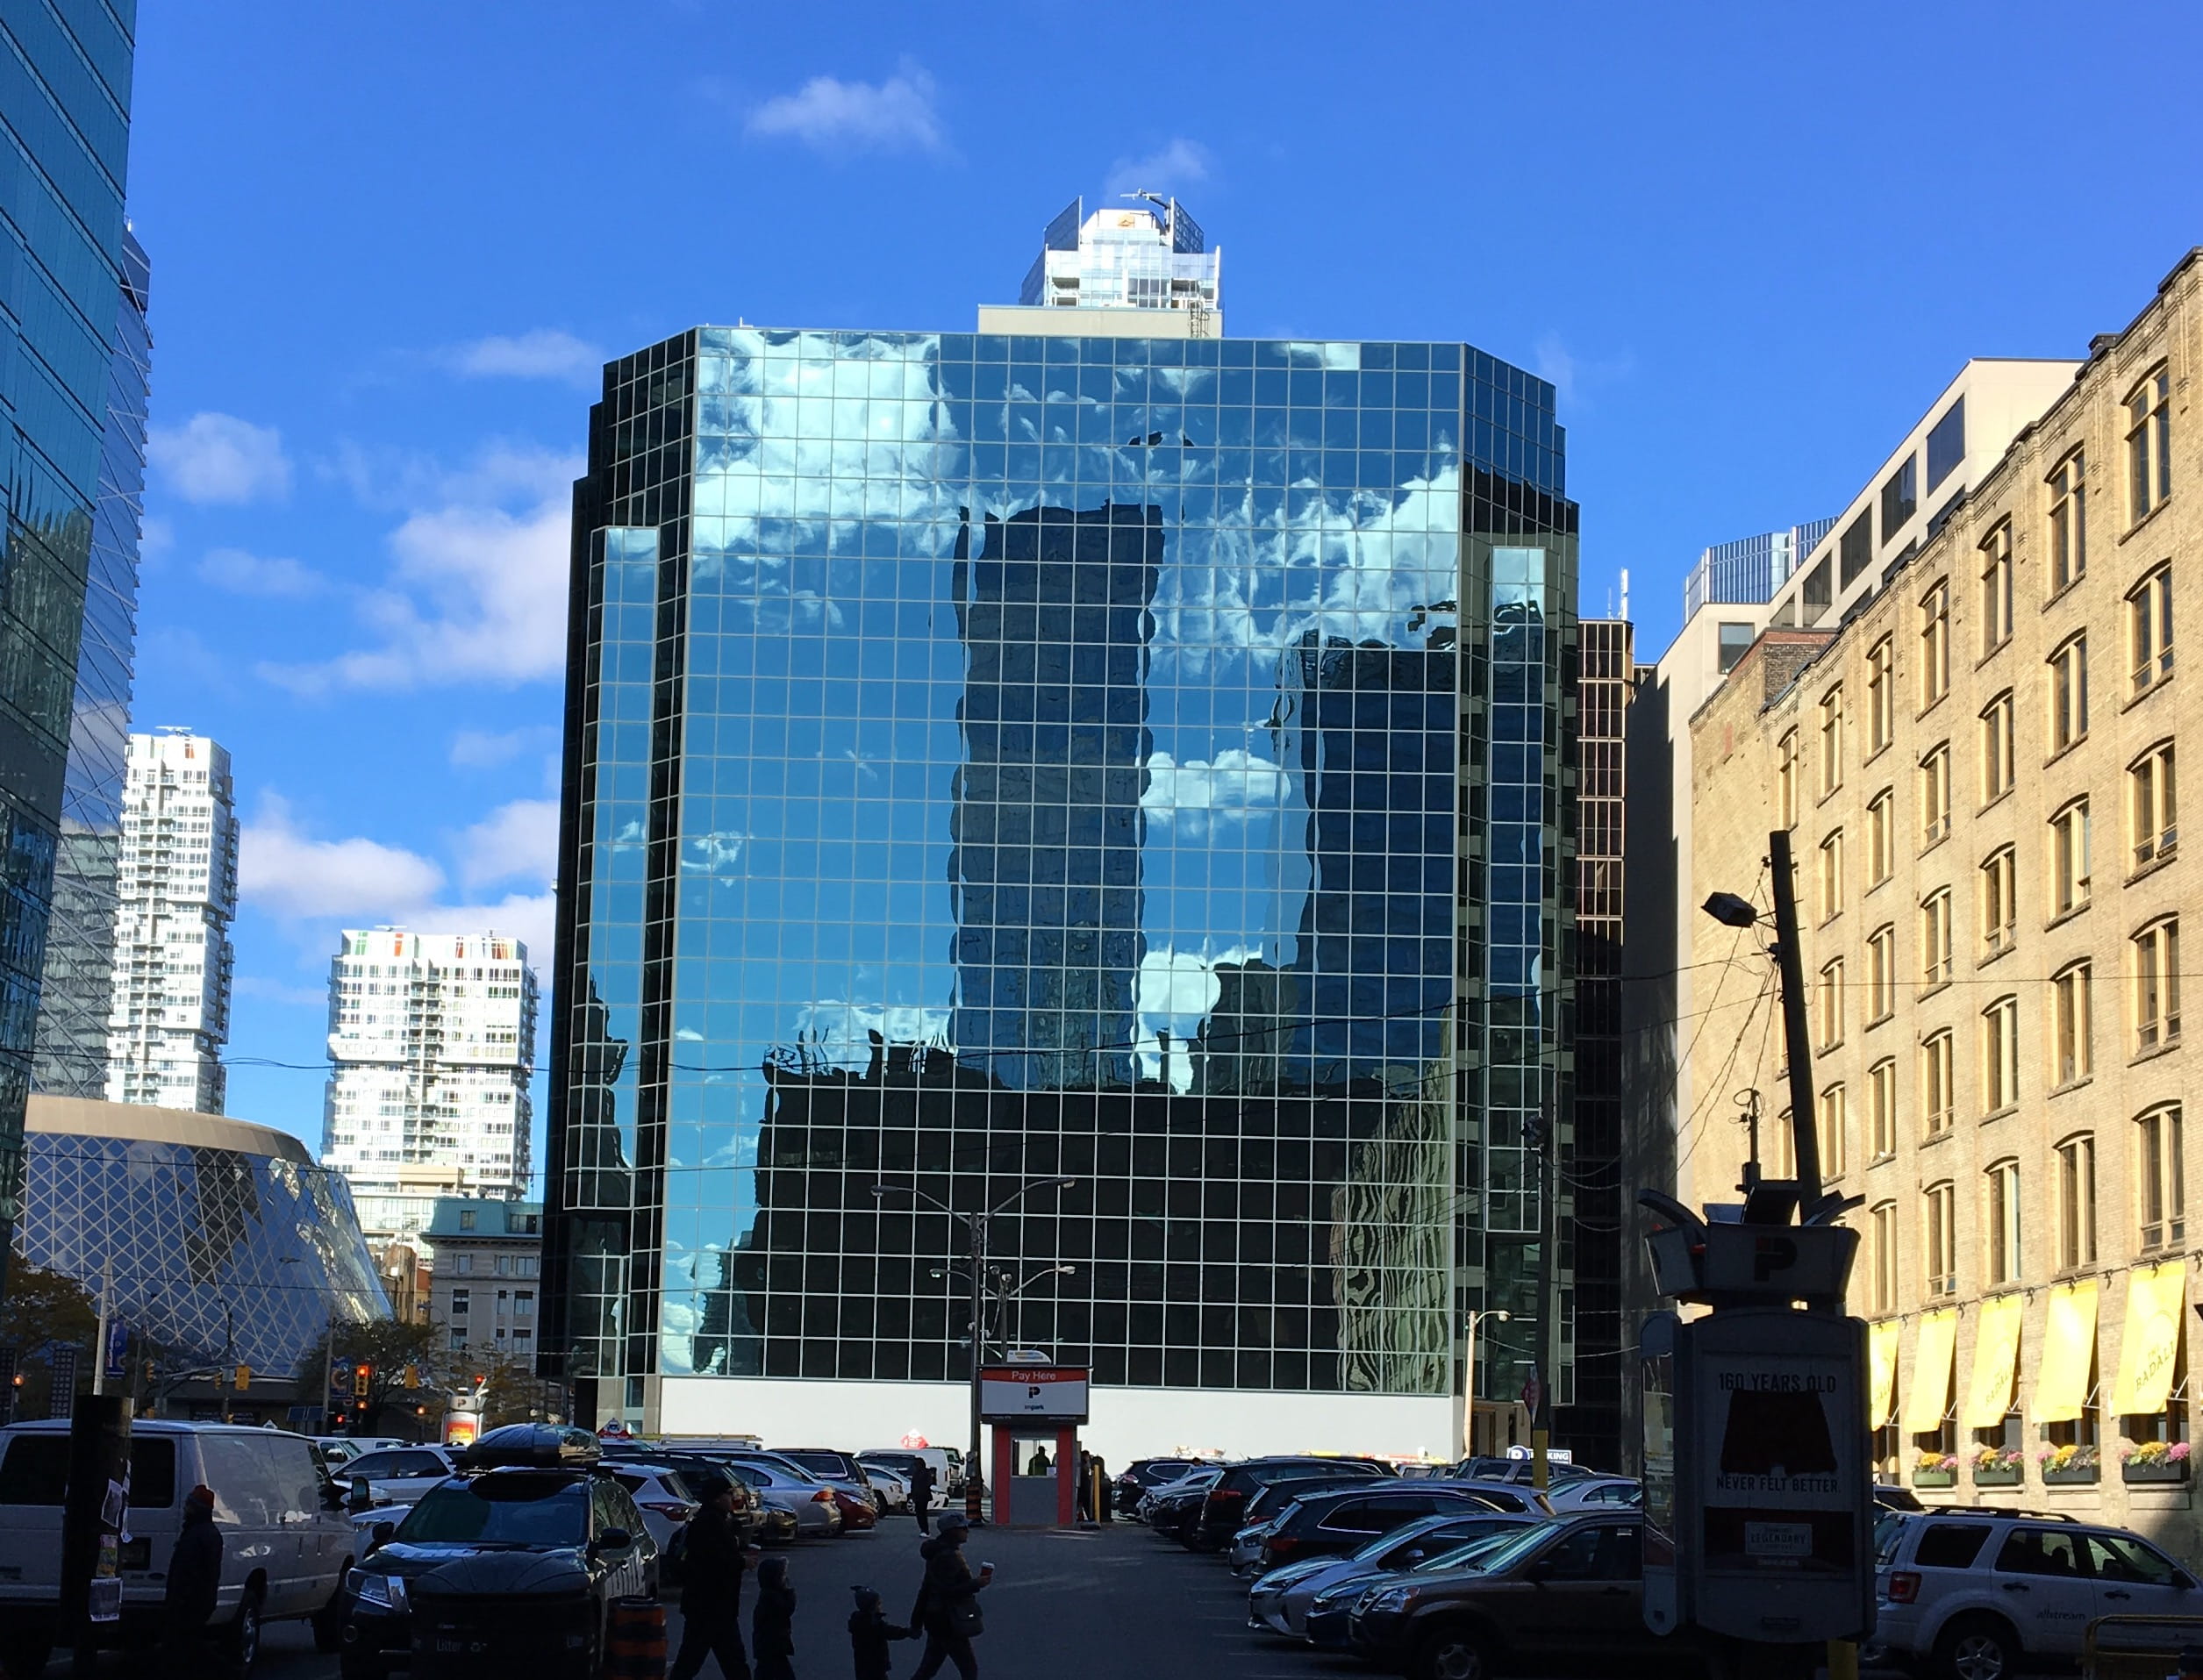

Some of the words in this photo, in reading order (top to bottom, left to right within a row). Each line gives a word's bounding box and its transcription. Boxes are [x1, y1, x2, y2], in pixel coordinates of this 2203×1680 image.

[1012, 1370, 1030, 1382] Pay
[1033, 1370, 1056, 1381] Here
[1720, 1373, 1744, 1390] 160
[1751, 1374, 1801, 1392] YEARS
[1806, 1375, 1836, 1393] OLD
[1716, 1476, 1755, 1490] NEVER
[1760, 1477, 1786, 1491] FELT
